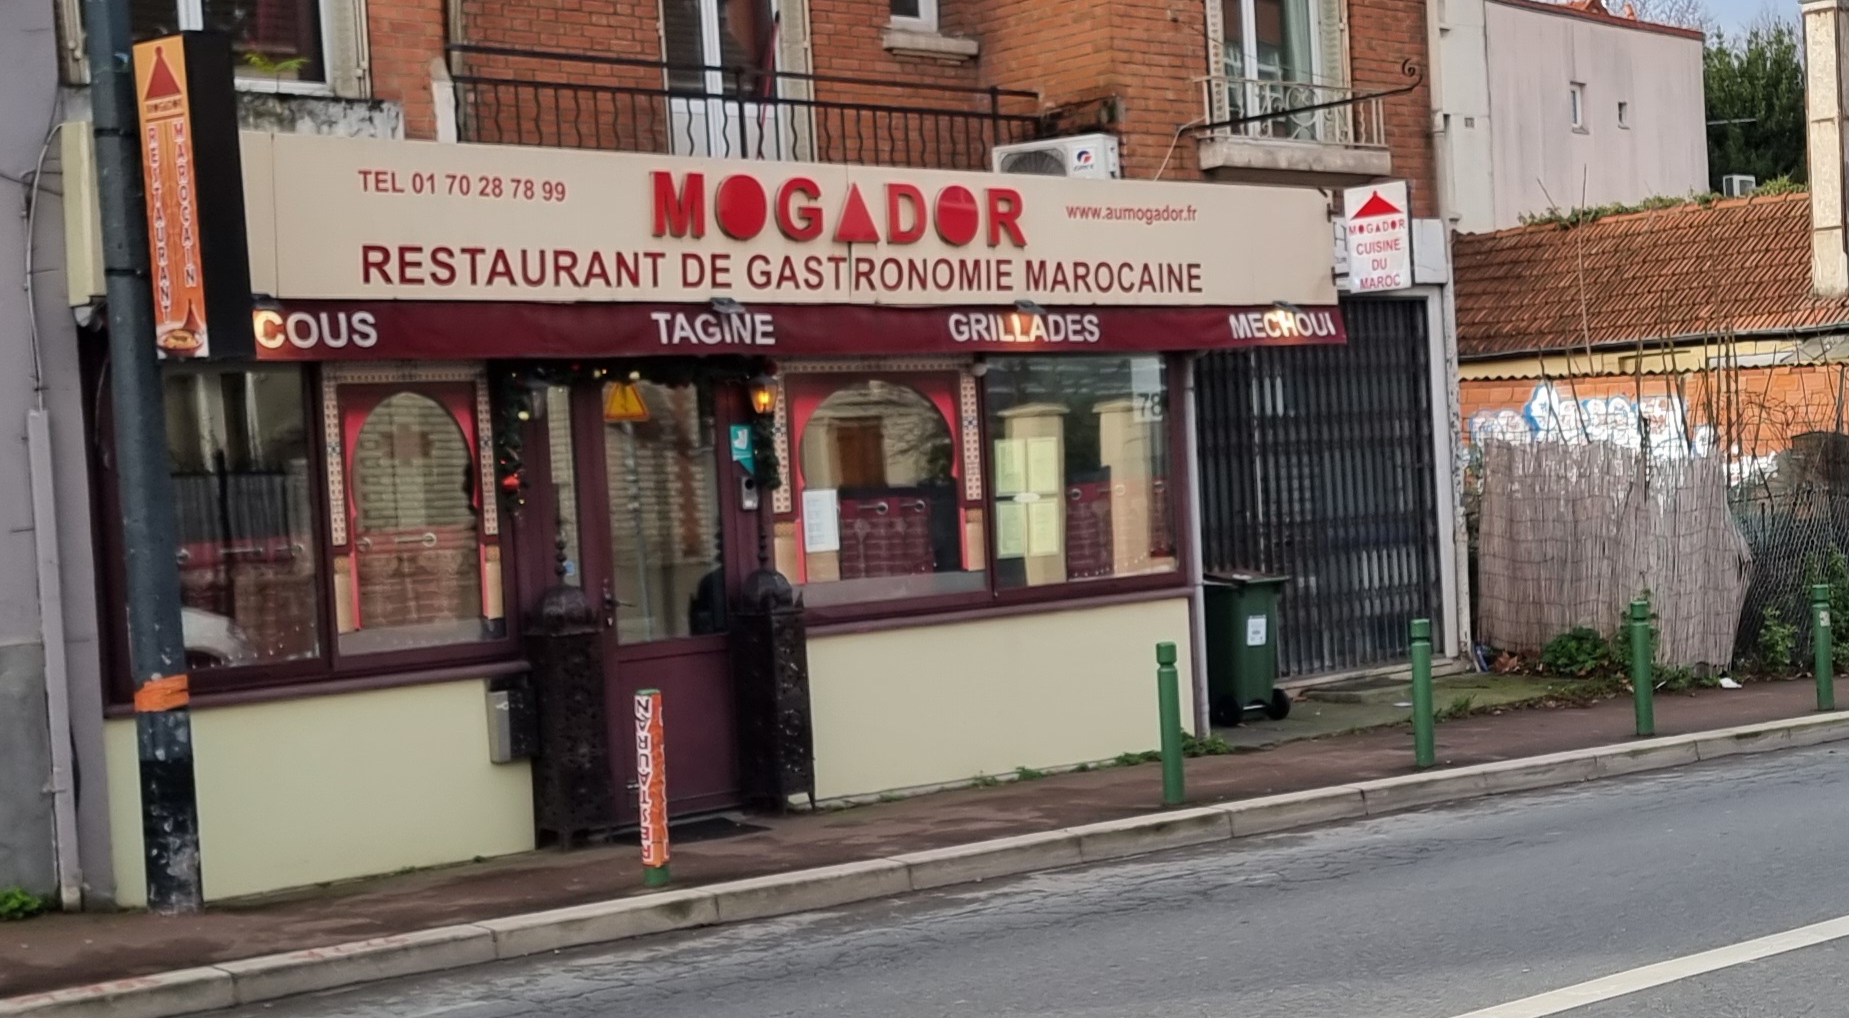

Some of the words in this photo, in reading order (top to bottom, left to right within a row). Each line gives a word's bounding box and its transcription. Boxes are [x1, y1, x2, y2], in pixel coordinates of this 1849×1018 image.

[358, 170, 404, 193] TEL
[412, 172, 435, 194] 01
[445, 174, 471, 196] 70
[478, 176, 503, 198] 28
[510, 178, 535, 200] 78
[542, 180, 566, 202] 99
[651, 170, 1027, 247] MOGADOR
[1065, 204, 1197, 225] www.aumogador.fr
[1348, 219, 1406, 236] MOGADOR
[1356, 238, 1402, 256] CUISINE
[361, 245, 666, 288] RESTAURANT
[681, 253, 733, 290] DE
[746, 254, 1014, 292] GASTRONOMIE
[1025, 260, 1203, 293] MAROCAINE
[1371, 258, 1388, 272] DU
[1359, 274, 1402, 291] MAROC
[651, 312, 776, 345] TAGINE
[948, 313, 1100, 344] GRILLADES
[1228, 310, 1337, 340] MECHOUI
[1137, 392, 1162, 418] 78
